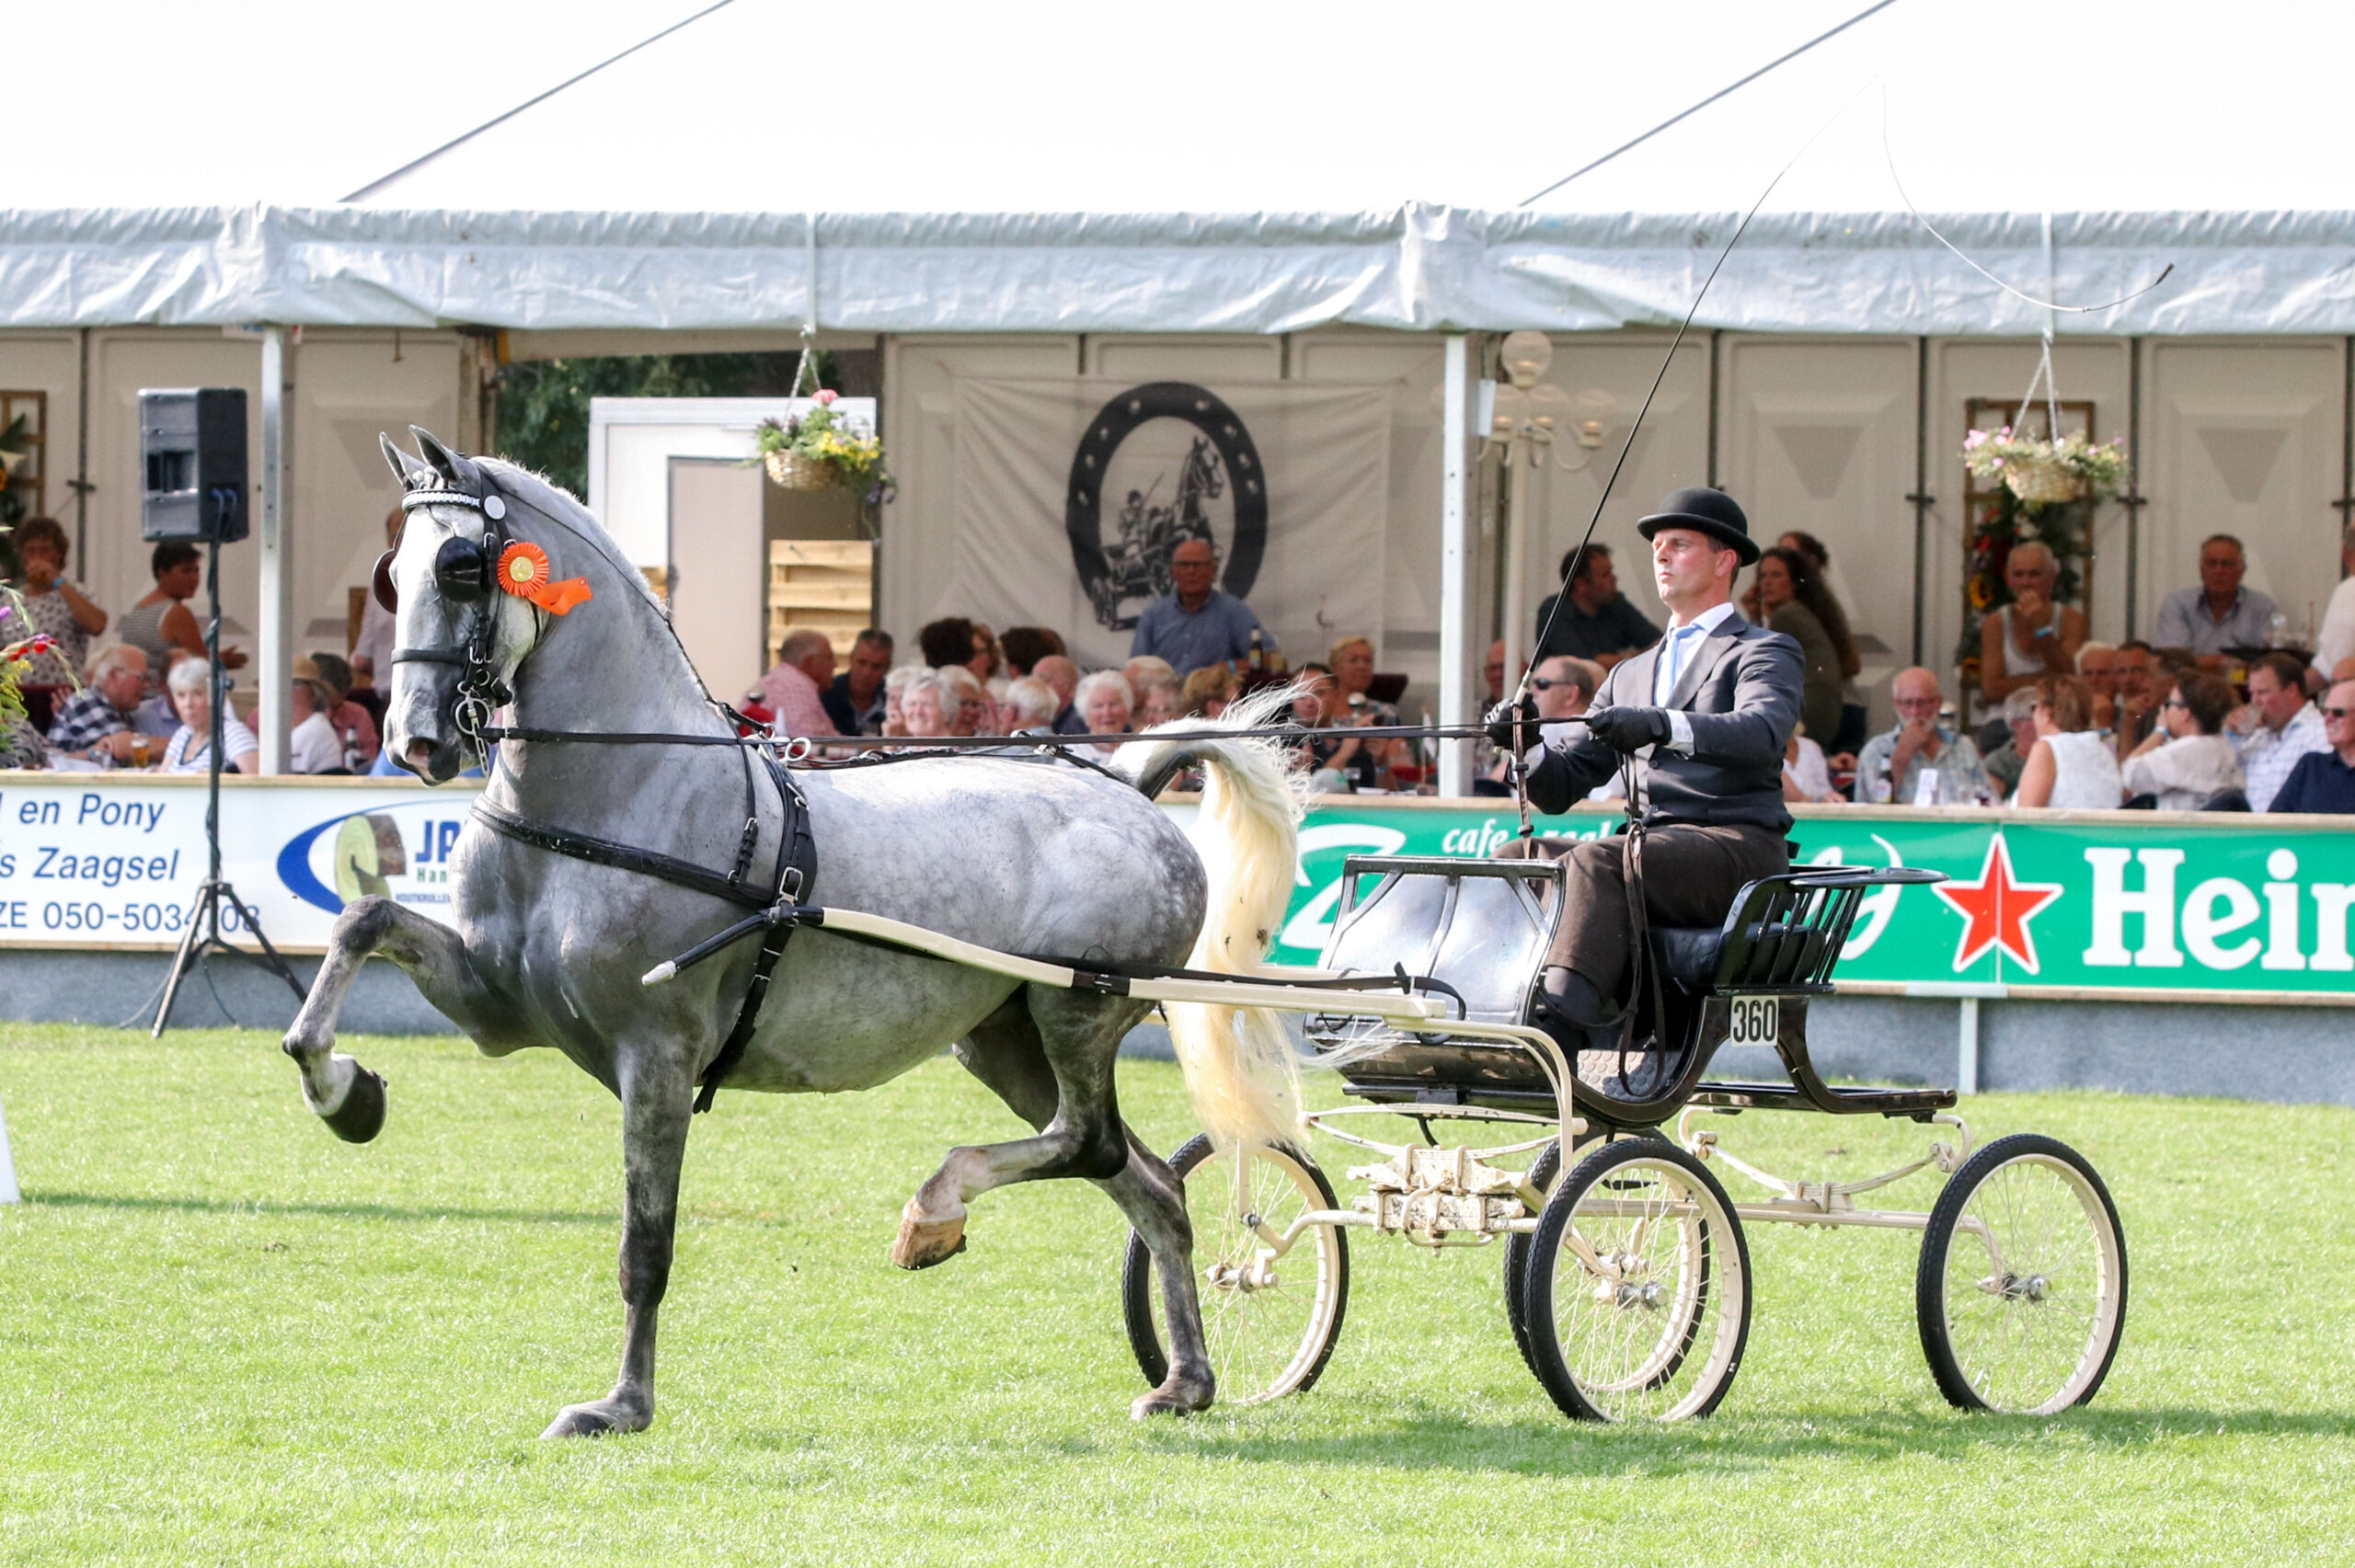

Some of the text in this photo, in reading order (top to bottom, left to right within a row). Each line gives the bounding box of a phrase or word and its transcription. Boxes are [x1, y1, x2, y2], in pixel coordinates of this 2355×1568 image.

[19, 800, 61, 825] en
[77, 793, 166, 833] Pony
[32, 846, 180, 887] Zaagsel
[43, 901, 260, 933] 050-50308
[1733, 999, 1777, 1043] 360
